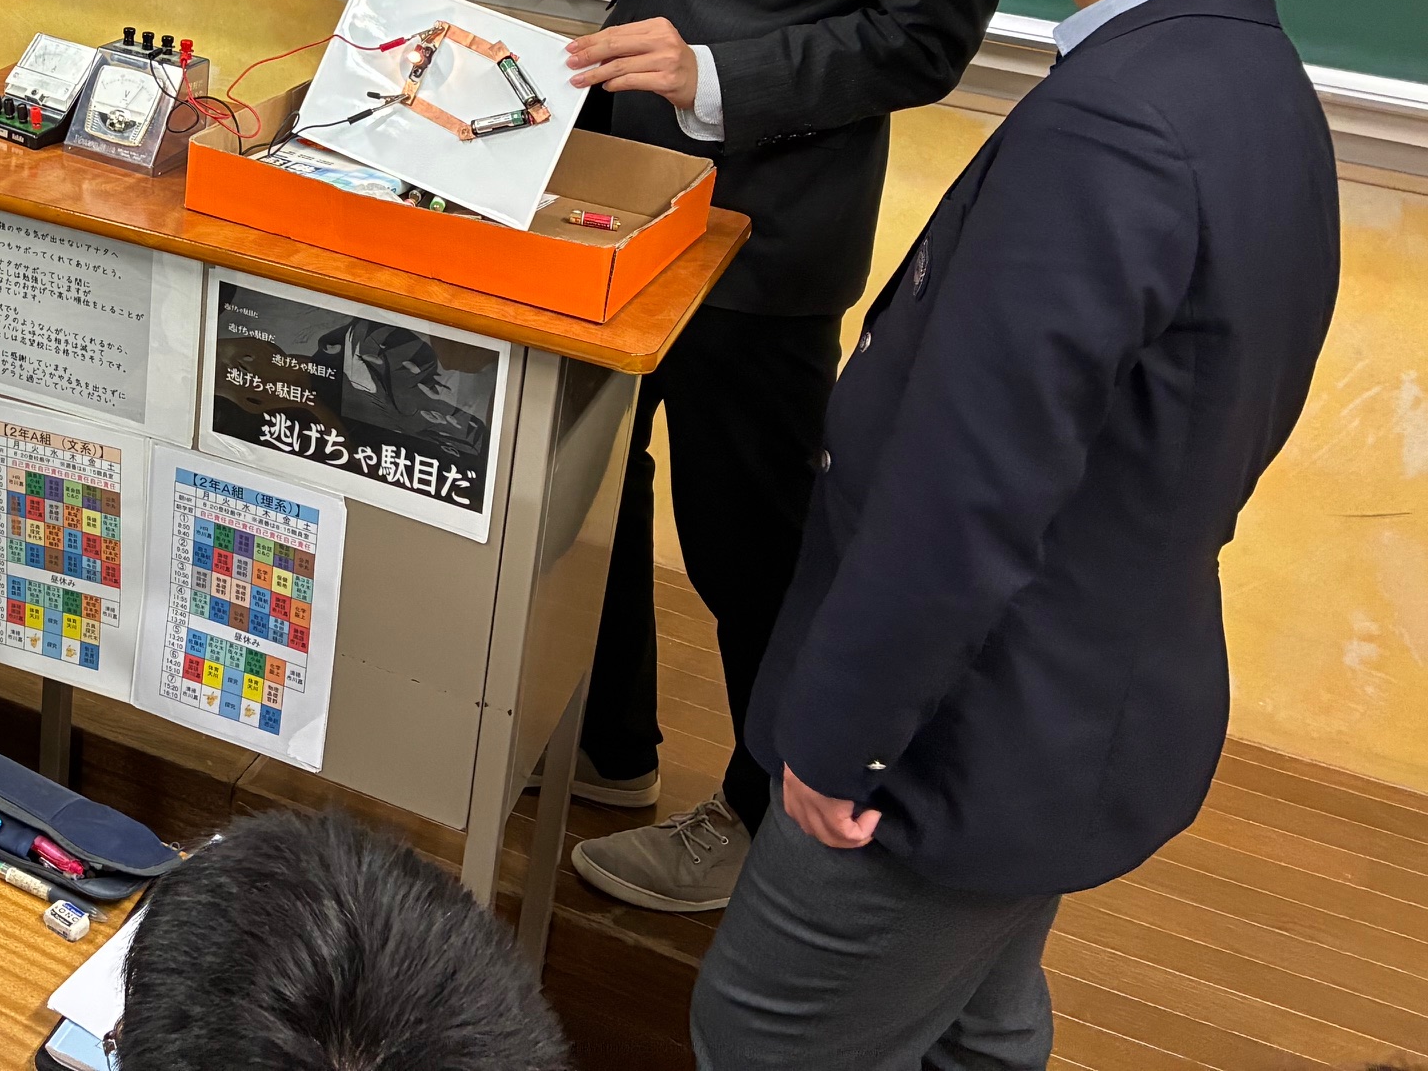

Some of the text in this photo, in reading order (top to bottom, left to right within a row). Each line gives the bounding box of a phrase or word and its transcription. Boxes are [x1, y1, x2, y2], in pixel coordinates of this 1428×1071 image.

[228, 323, 276, 343] 逃げちゃ駄目だ
[272, 354, 337, 380] 逃げちゃ駄目だ
[226, 368, 317, 405] 逃げちゃ駄目だ
[259, 412, 477, 506] 逃げちゃ駄目だ
